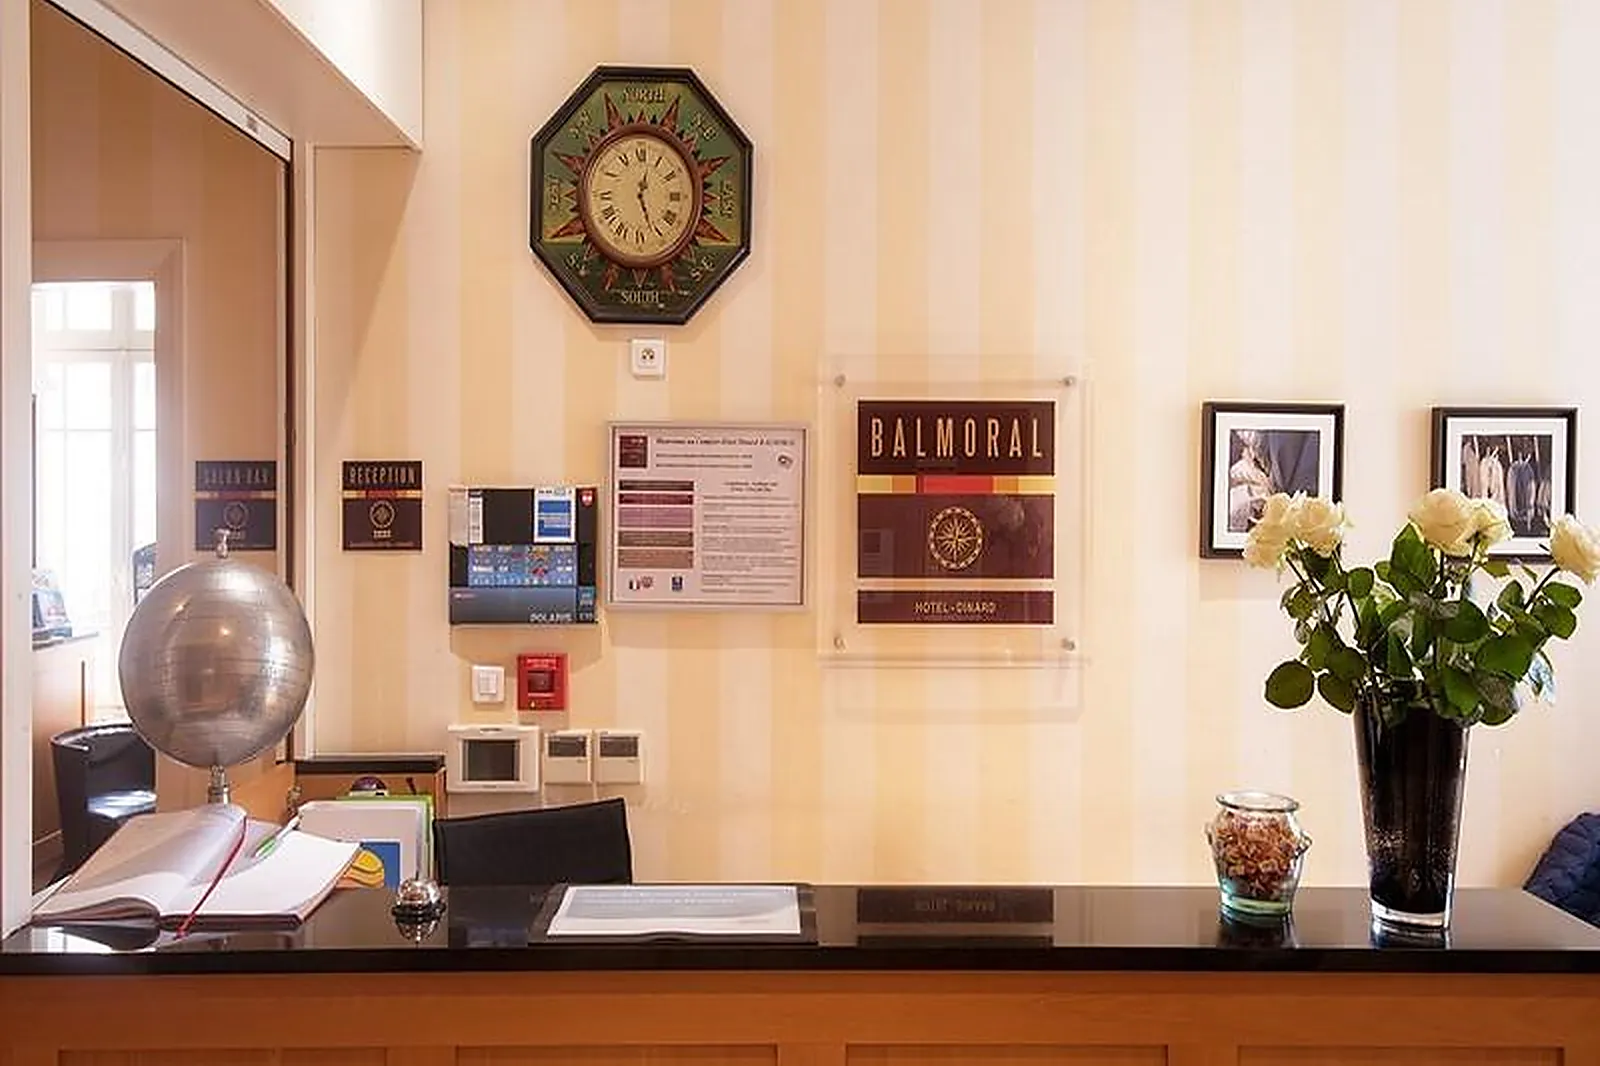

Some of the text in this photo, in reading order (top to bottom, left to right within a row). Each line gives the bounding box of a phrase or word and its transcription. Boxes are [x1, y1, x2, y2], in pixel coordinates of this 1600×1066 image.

[621, 291, 660, 303] SOUTH
[871, 417, 1043, 458] BALMORAL
[349, 467, 415, 484] RECEPTION
